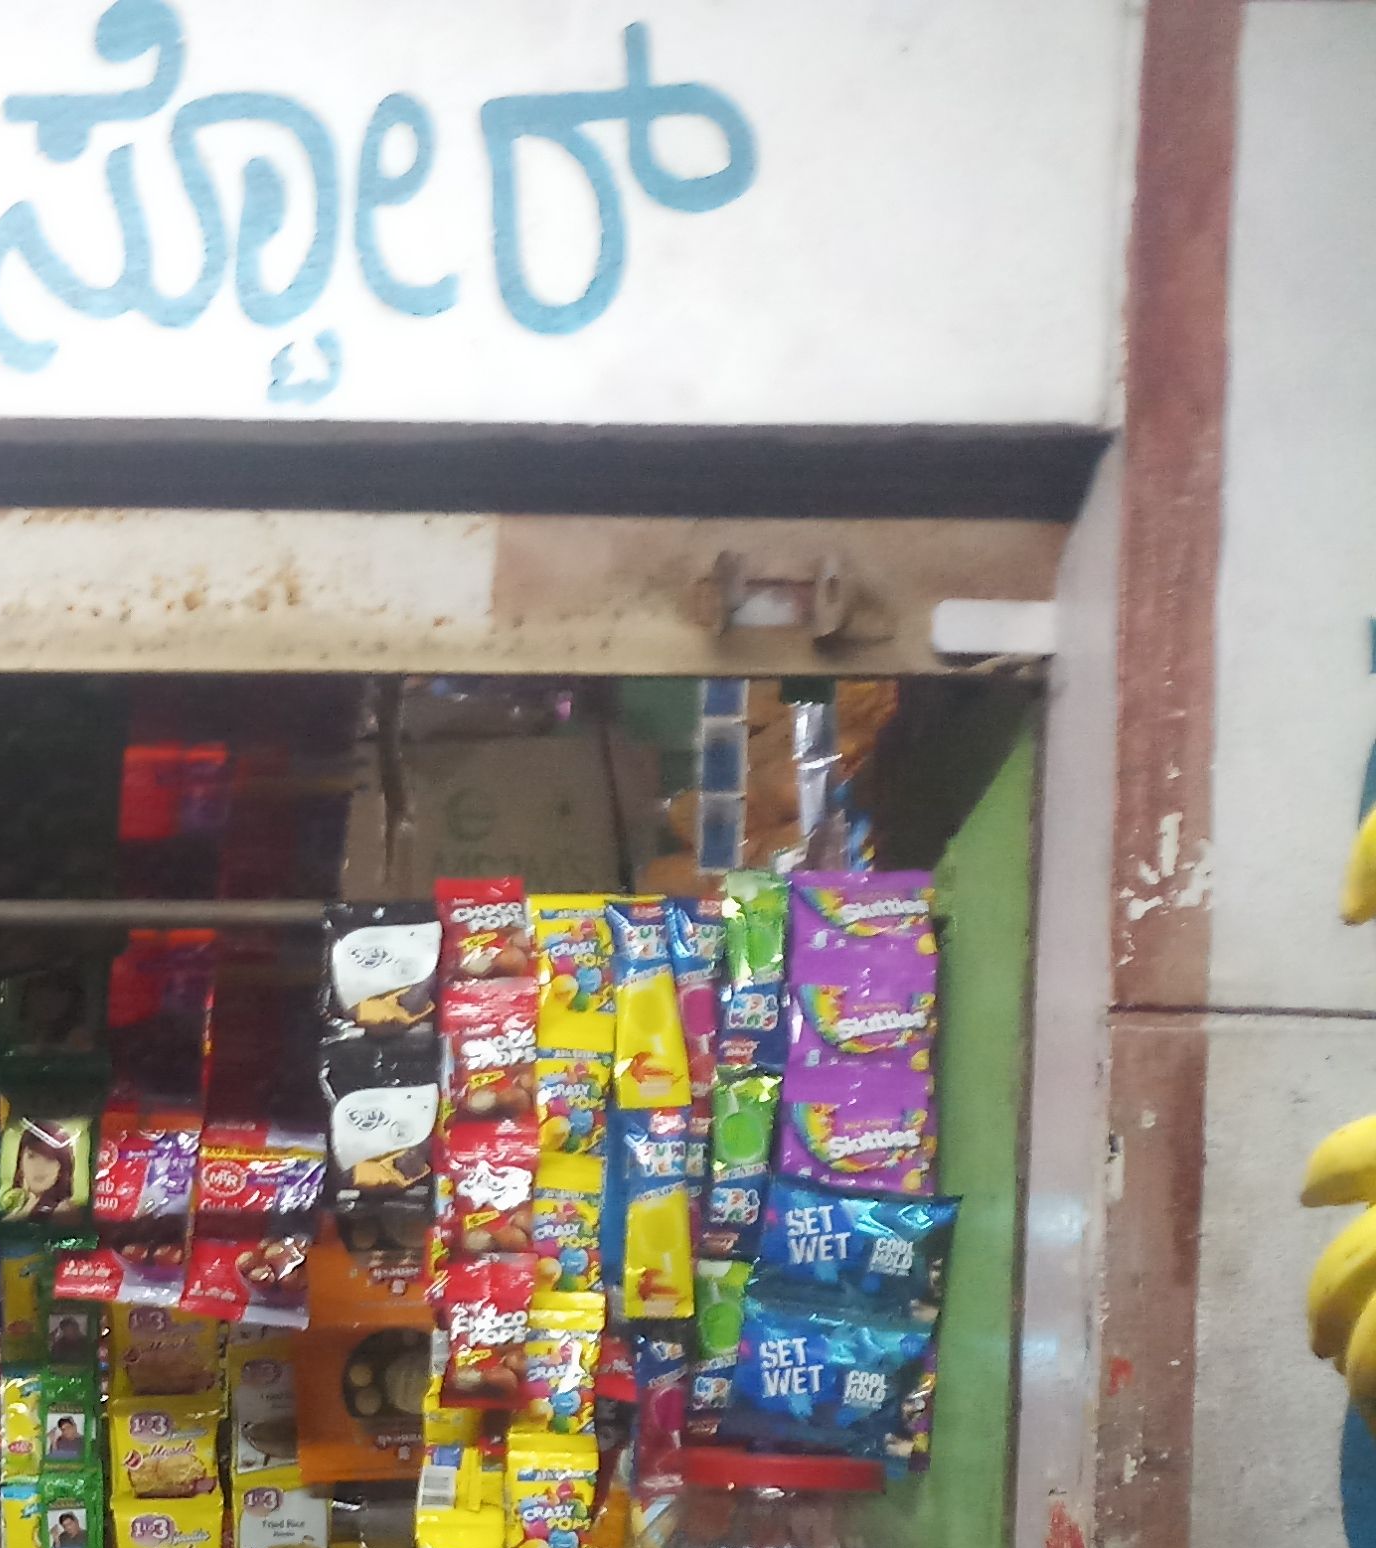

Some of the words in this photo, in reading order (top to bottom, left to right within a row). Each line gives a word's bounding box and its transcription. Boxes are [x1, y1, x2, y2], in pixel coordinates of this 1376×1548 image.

[451, 902, 523, 923] CHOCO
[550, 941, 597, 957] CRAZY
[209, 1168, 239, 1188] MTR
[533, 1222, 581, 1240] CRAZY
[785, 1205, 834, 1237] SET
[788, 1232, 851, 1265] WET
[874, 1237, 915, 1258] COOL
[759, 1337, 808, 1370] SET
[761, 1364, 824, 1399] WET
[522, 1503, 574, 1521] CRAZY
[547, 1516, 590, 1531] POPS
